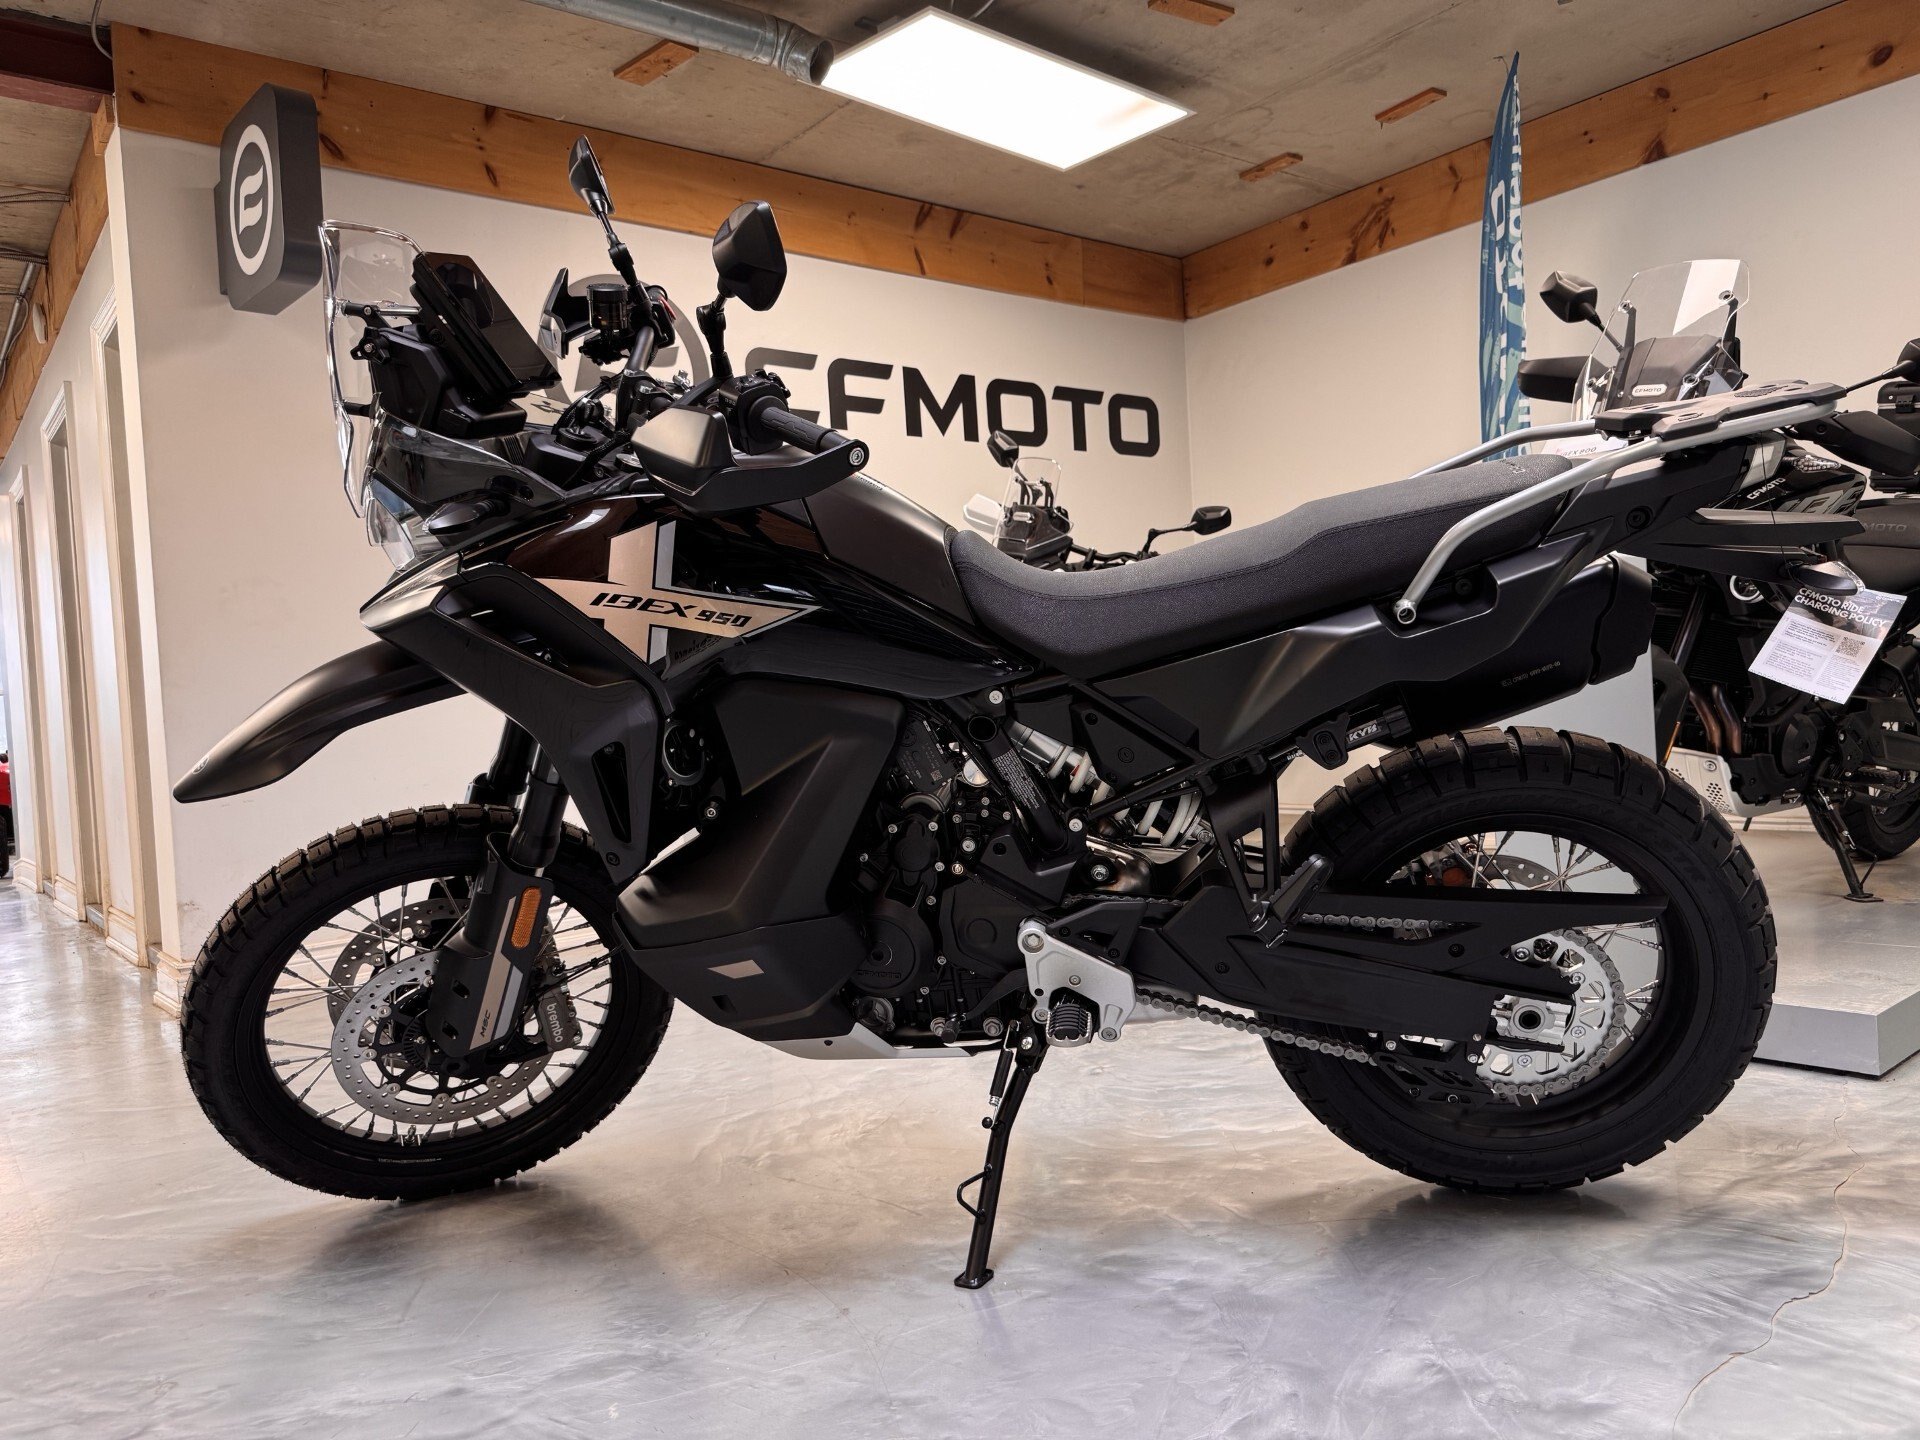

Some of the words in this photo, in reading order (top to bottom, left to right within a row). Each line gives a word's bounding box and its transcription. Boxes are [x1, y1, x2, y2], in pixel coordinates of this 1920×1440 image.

[1746, 477, 1787, 500] CFMOTO
[1863, 522, 1907, 532] MOTO
[589, 592, 698, 618] IBEX
[694, 609, 753, 627] 950
[1794, 595, 1849, 619] CHARGING
[1849, 612, 1888, 627] POLICY
[1799, 587, 1841, 607] CFMOTO
[1842, 601, 1866, 614] RIDE
[1348, 723, 1378, 742] KYB
[480, 1008, 491, 1037] MSC
[546, 1002, 564, 1043] brembo
